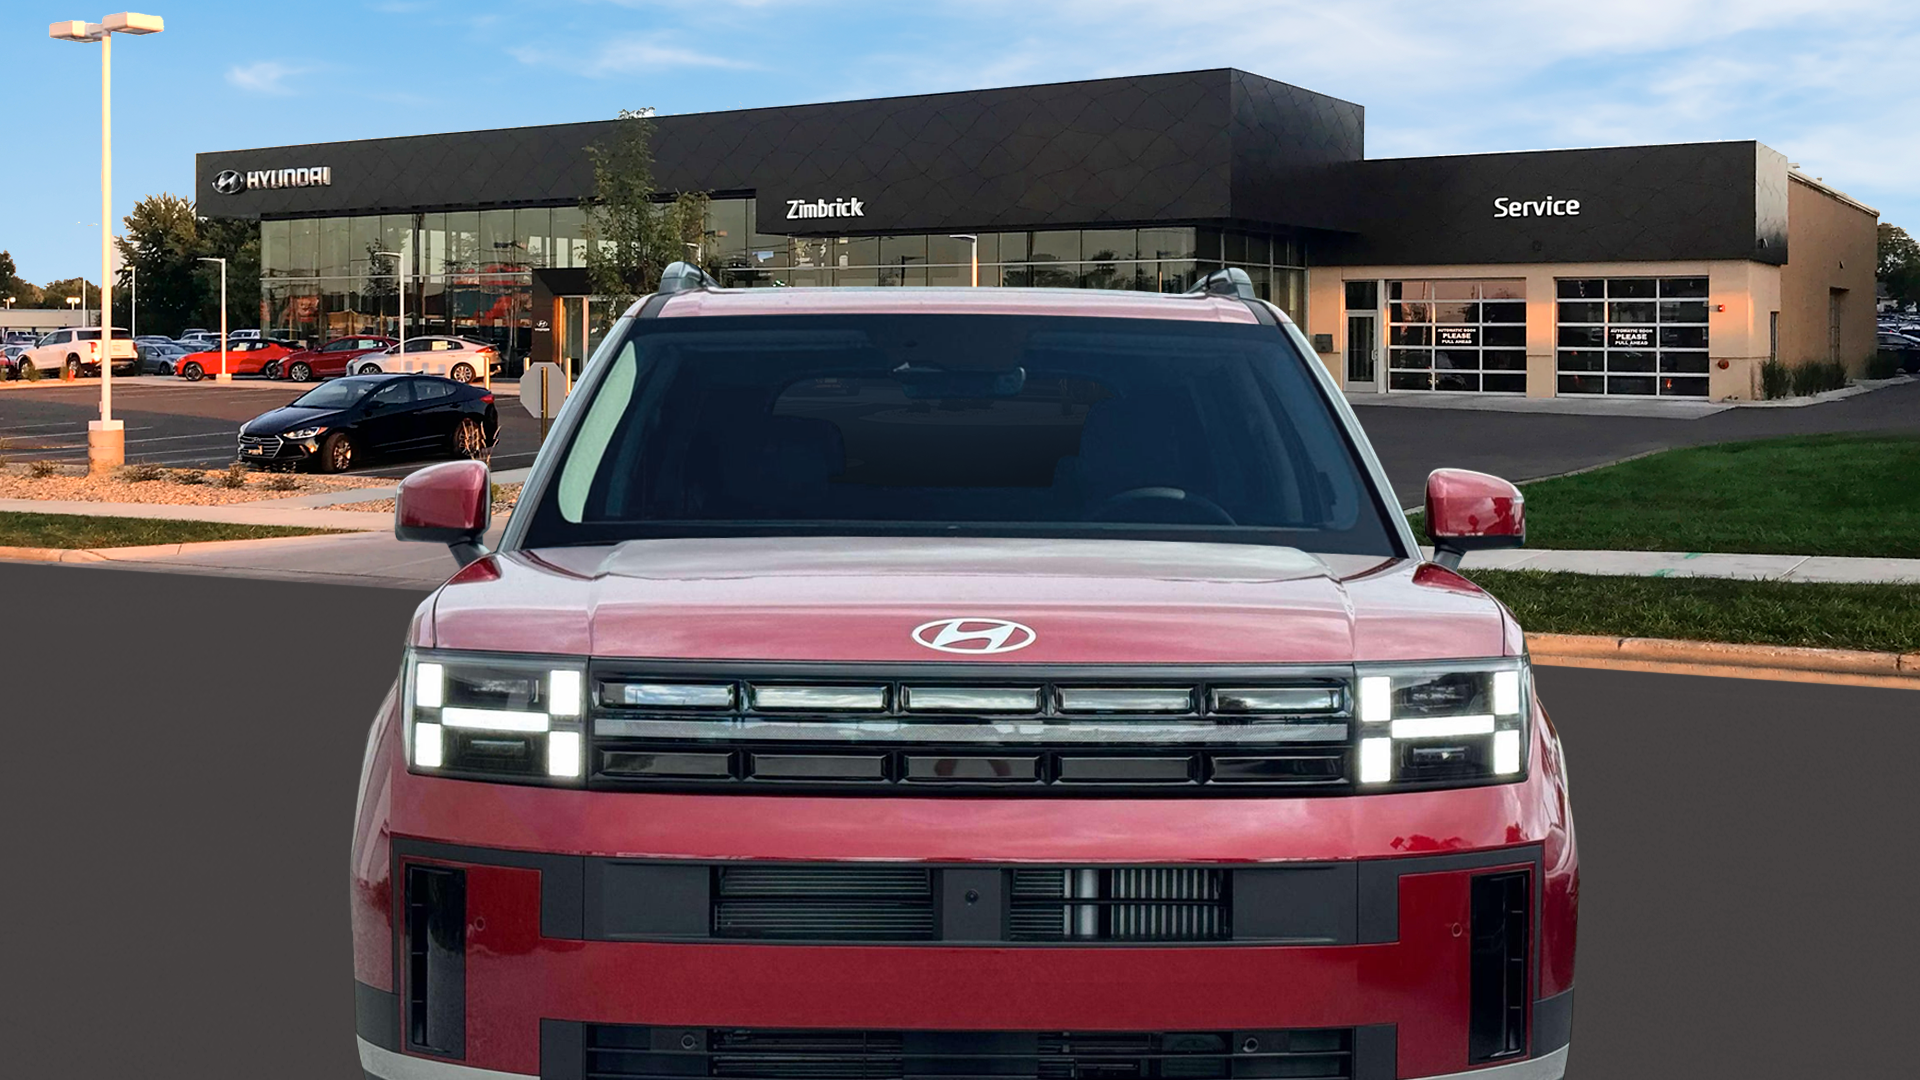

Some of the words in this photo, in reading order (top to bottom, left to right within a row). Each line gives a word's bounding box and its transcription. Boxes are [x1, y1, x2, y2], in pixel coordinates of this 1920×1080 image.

[247, 166, 331, 189] HYUNDAI
[786, 197, 865, 219] Zimbrick
[1493, 195, 1580, 217] Service
